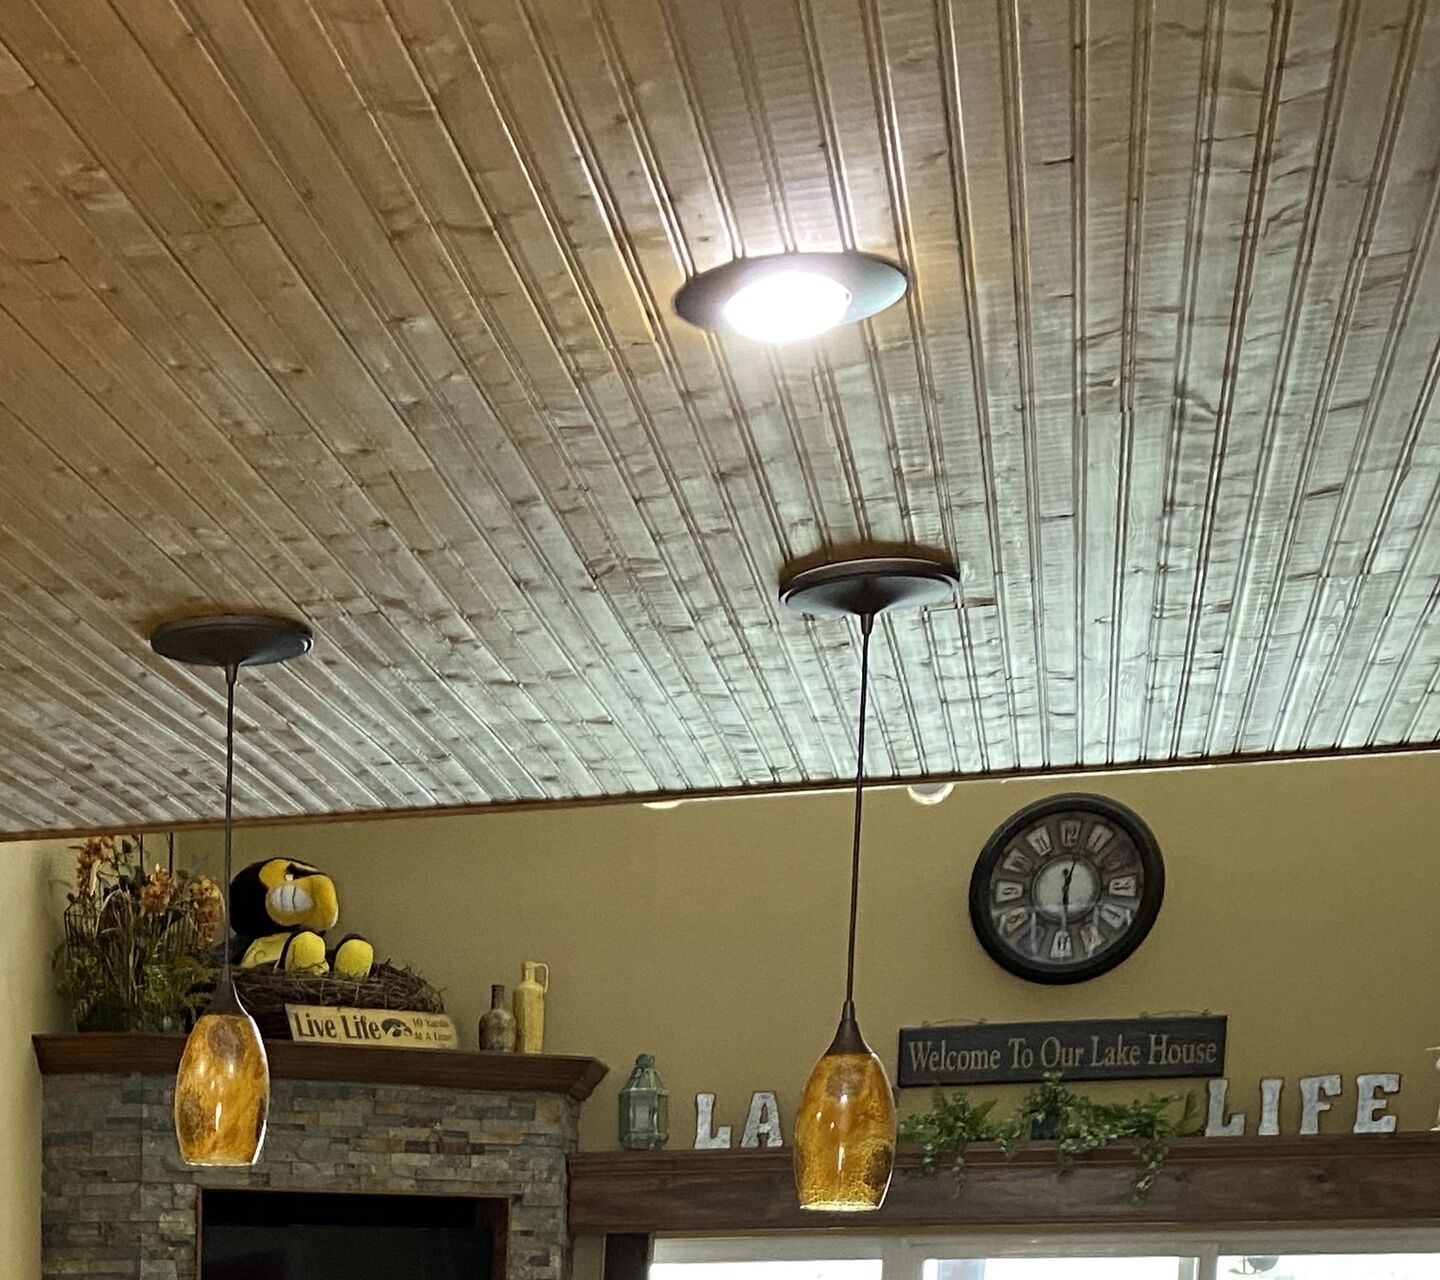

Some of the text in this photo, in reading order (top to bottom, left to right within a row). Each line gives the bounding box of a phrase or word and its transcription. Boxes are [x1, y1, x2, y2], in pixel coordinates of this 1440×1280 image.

[293, 1012, 382, 1041] Live Life
[908, 1032, 1218, 1072] Welcome To Our Lake House
[1205, 1073, 1401, 1137] LIFE
